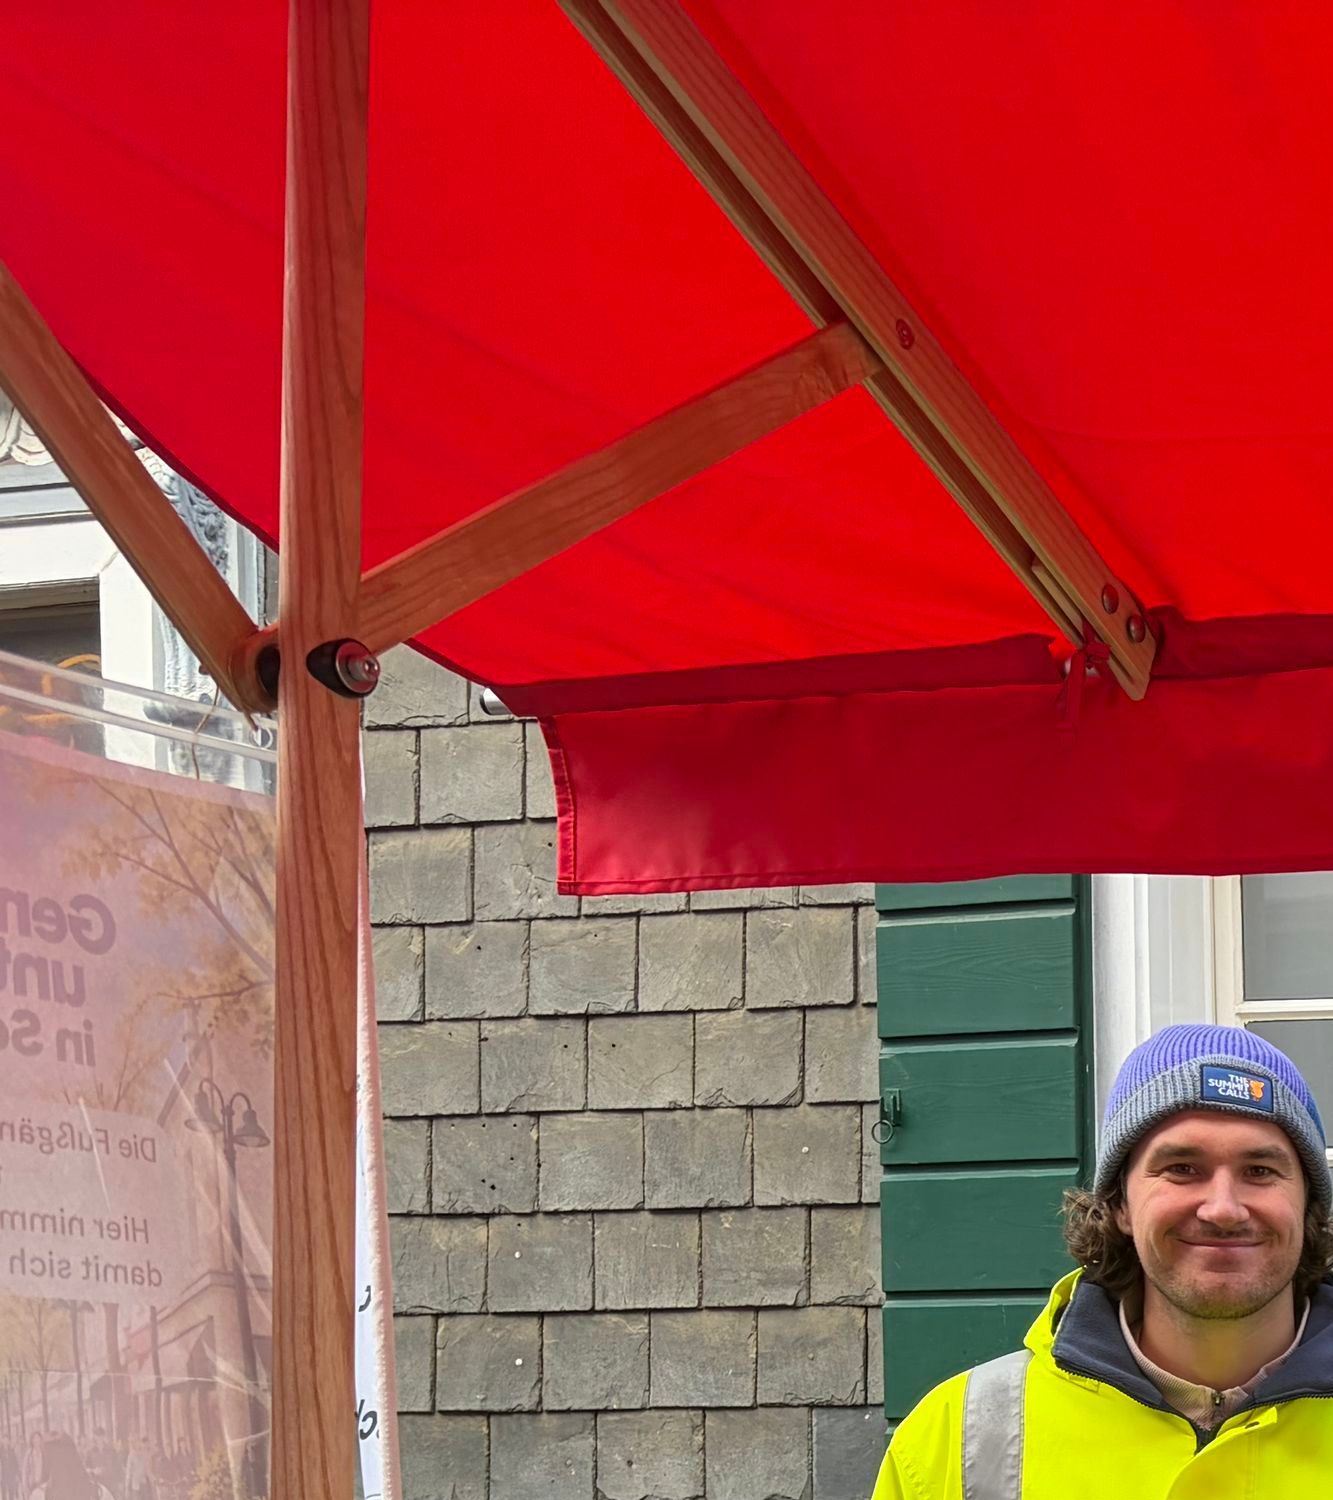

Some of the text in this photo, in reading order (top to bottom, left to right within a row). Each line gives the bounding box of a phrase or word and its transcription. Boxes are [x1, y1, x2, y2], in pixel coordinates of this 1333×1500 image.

[1208, 1078, 1250, 1092] SUMMIT
[1228, 1074, 1249, 1084] THE
[1218, 1087, 1250, 1100] CALLS
